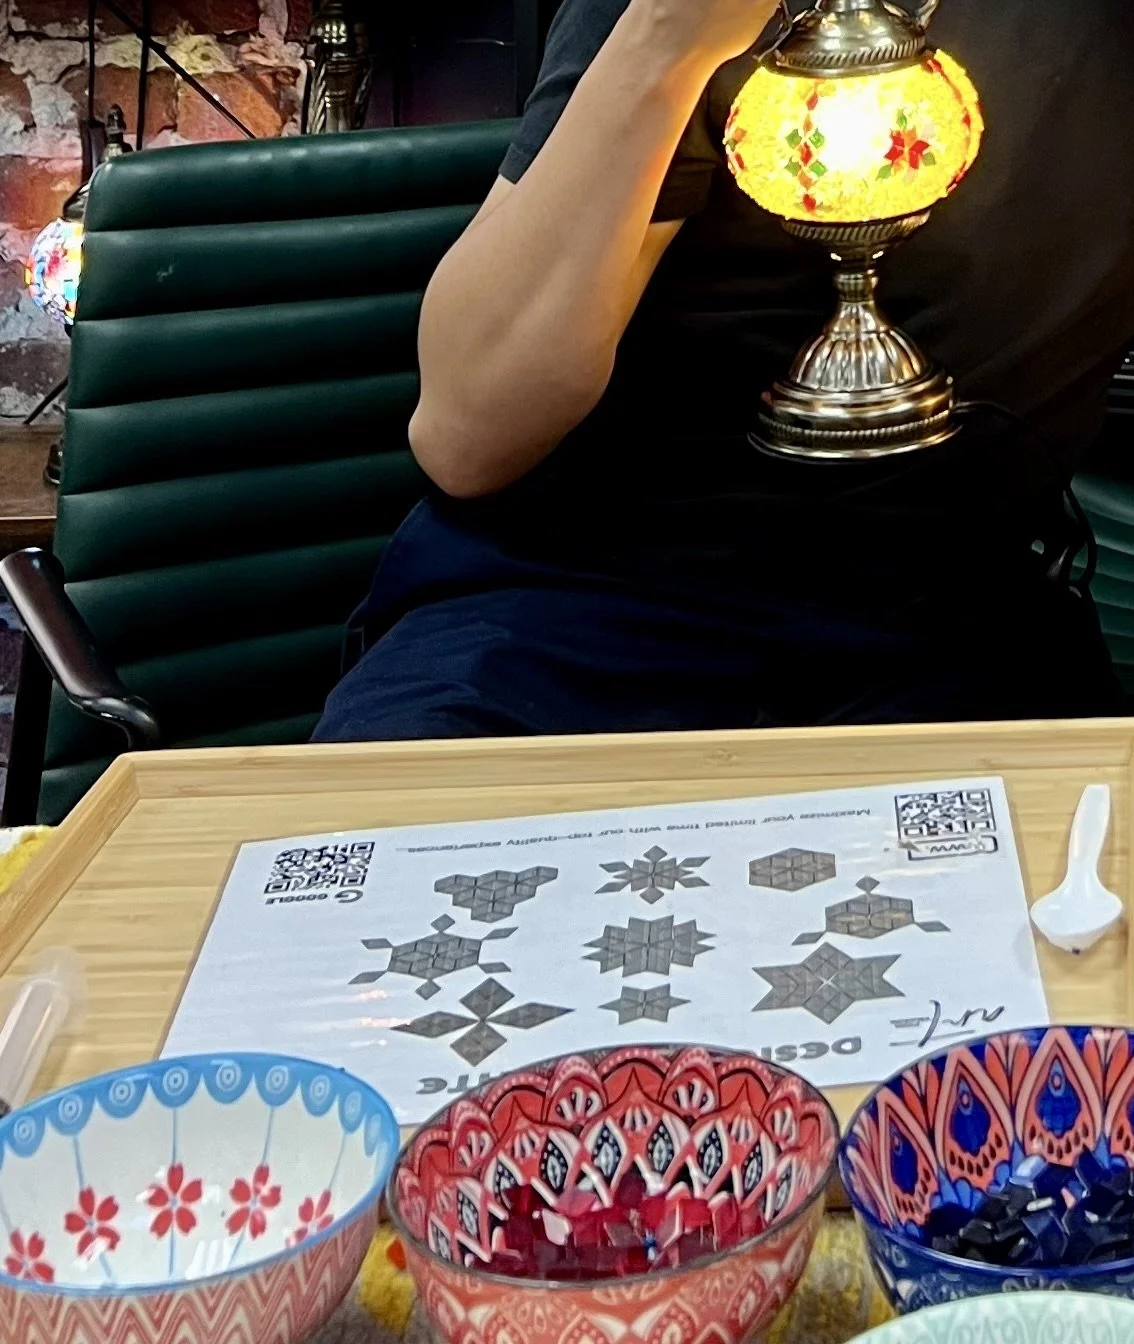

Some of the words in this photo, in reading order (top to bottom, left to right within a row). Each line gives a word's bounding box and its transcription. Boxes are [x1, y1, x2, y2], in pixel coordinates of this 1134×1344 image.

[705, 819, 757, 830] limited
[628, 826, 662, 835] with
[760, 1036, 862, 1063] DESI
